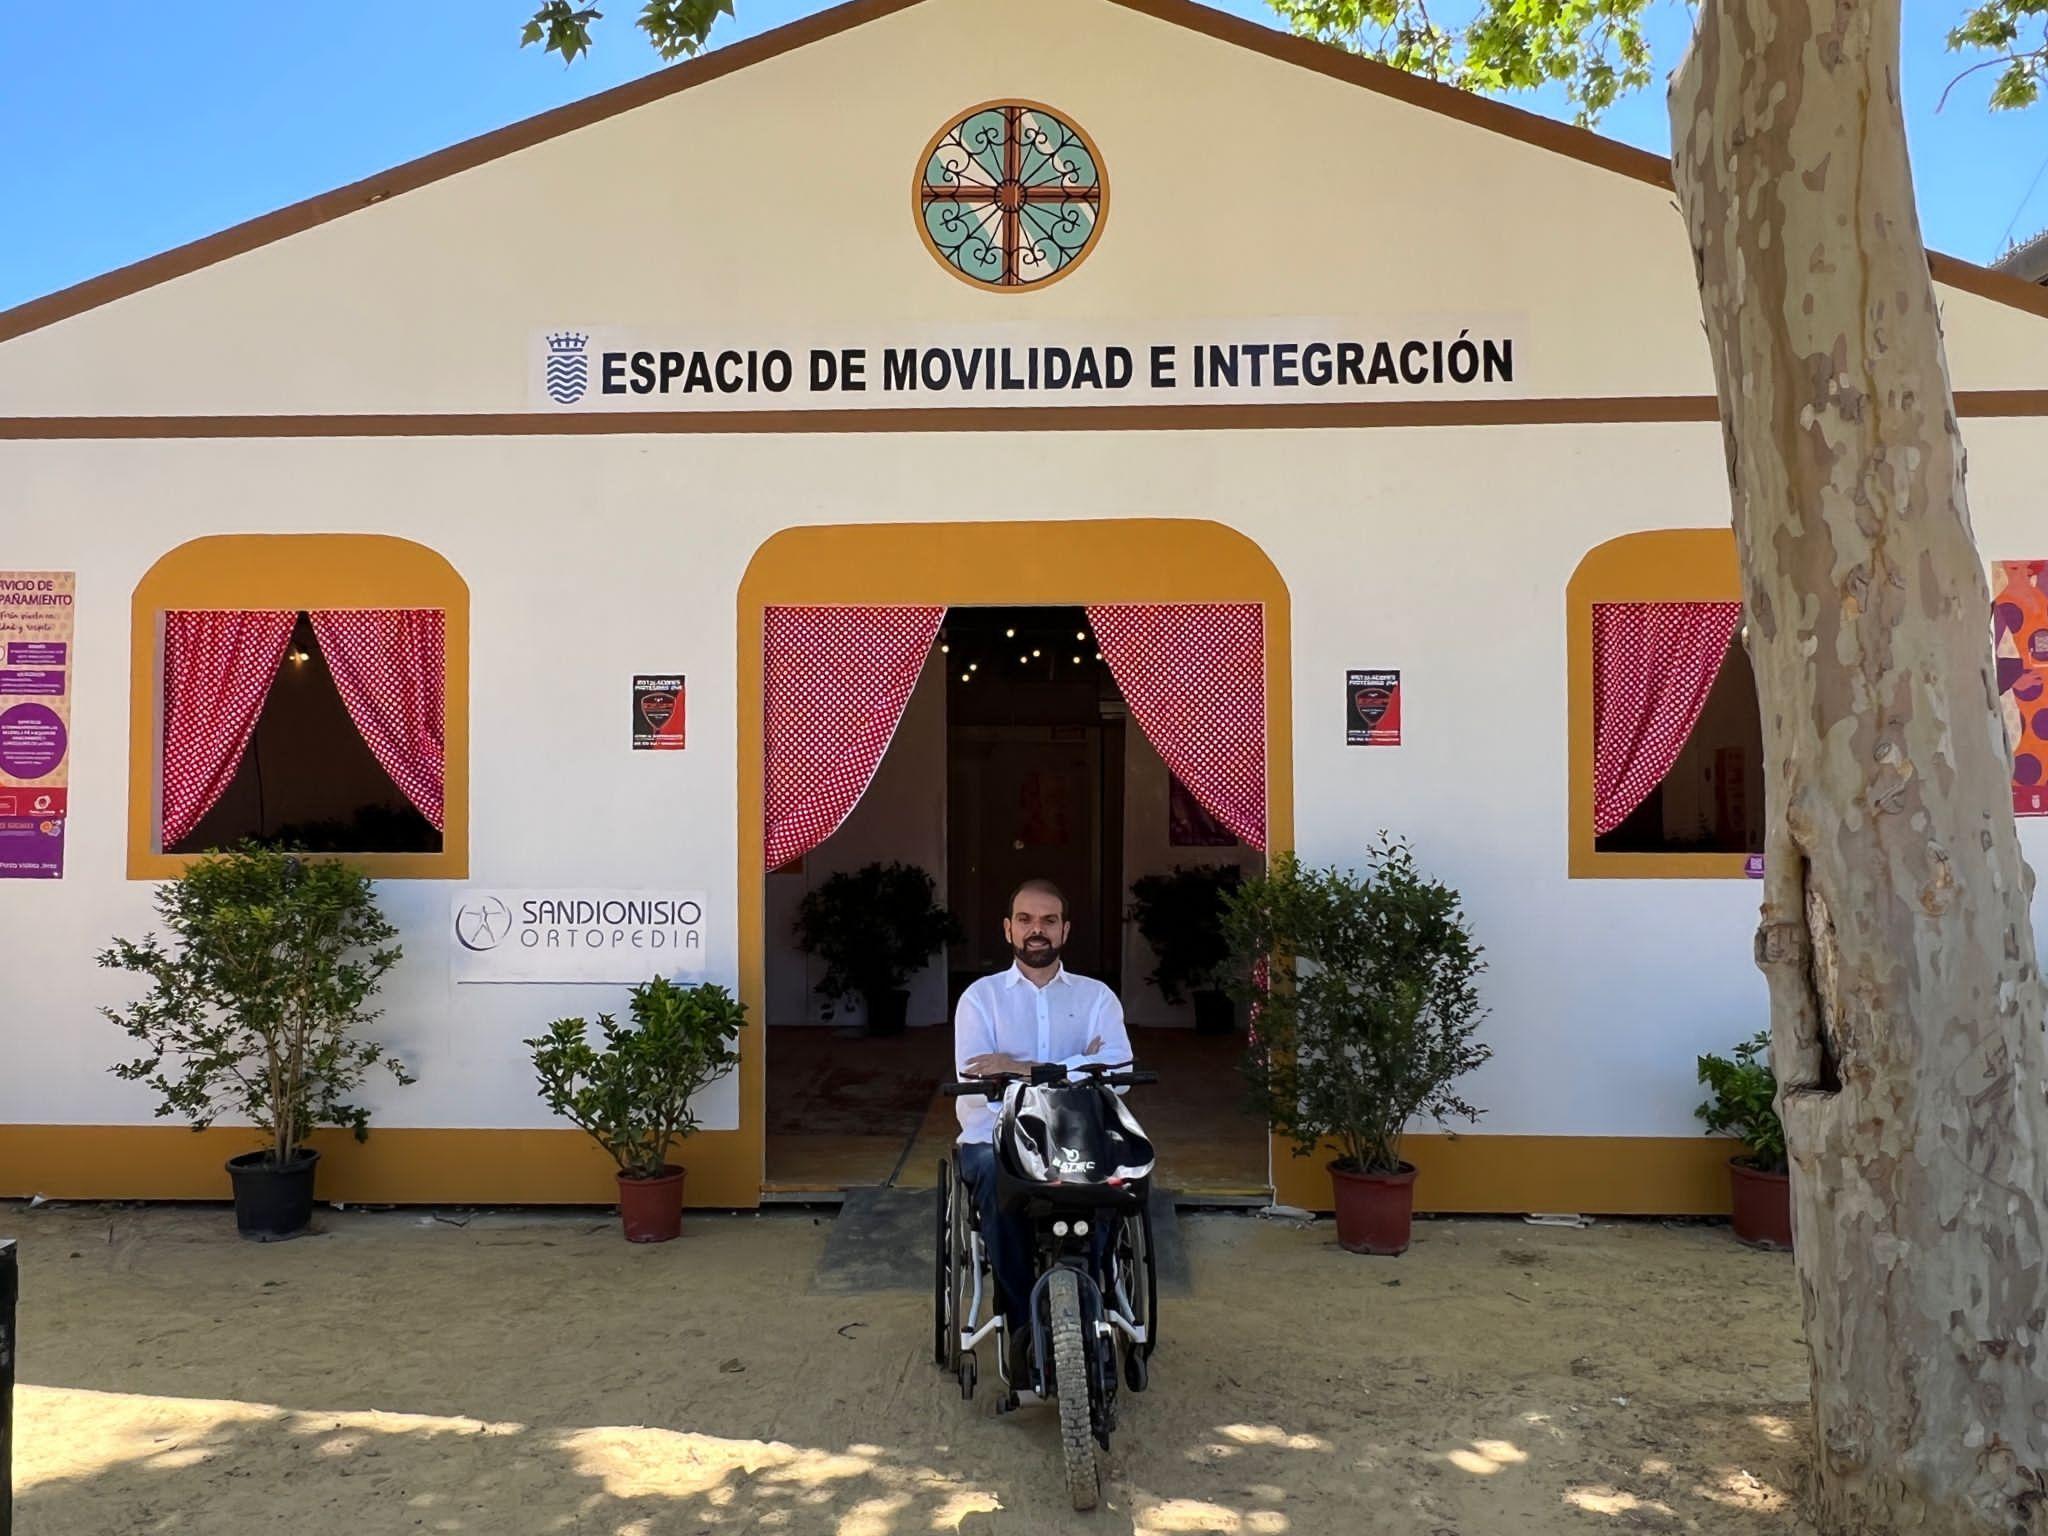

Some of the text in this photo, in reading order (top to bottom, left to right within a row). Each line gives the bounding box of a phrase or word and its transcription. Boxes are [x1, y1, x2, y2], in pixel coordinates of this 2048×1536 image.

[602, 329, 1513, 394] ESPACIO DE MOVILIDAD E INTEGRACIÓN
[38, 580, 53, 591] DE
[522, 900, 702, 926] SANDIONISIO
[520, 929, 700, 948] ORTOPEDIA
